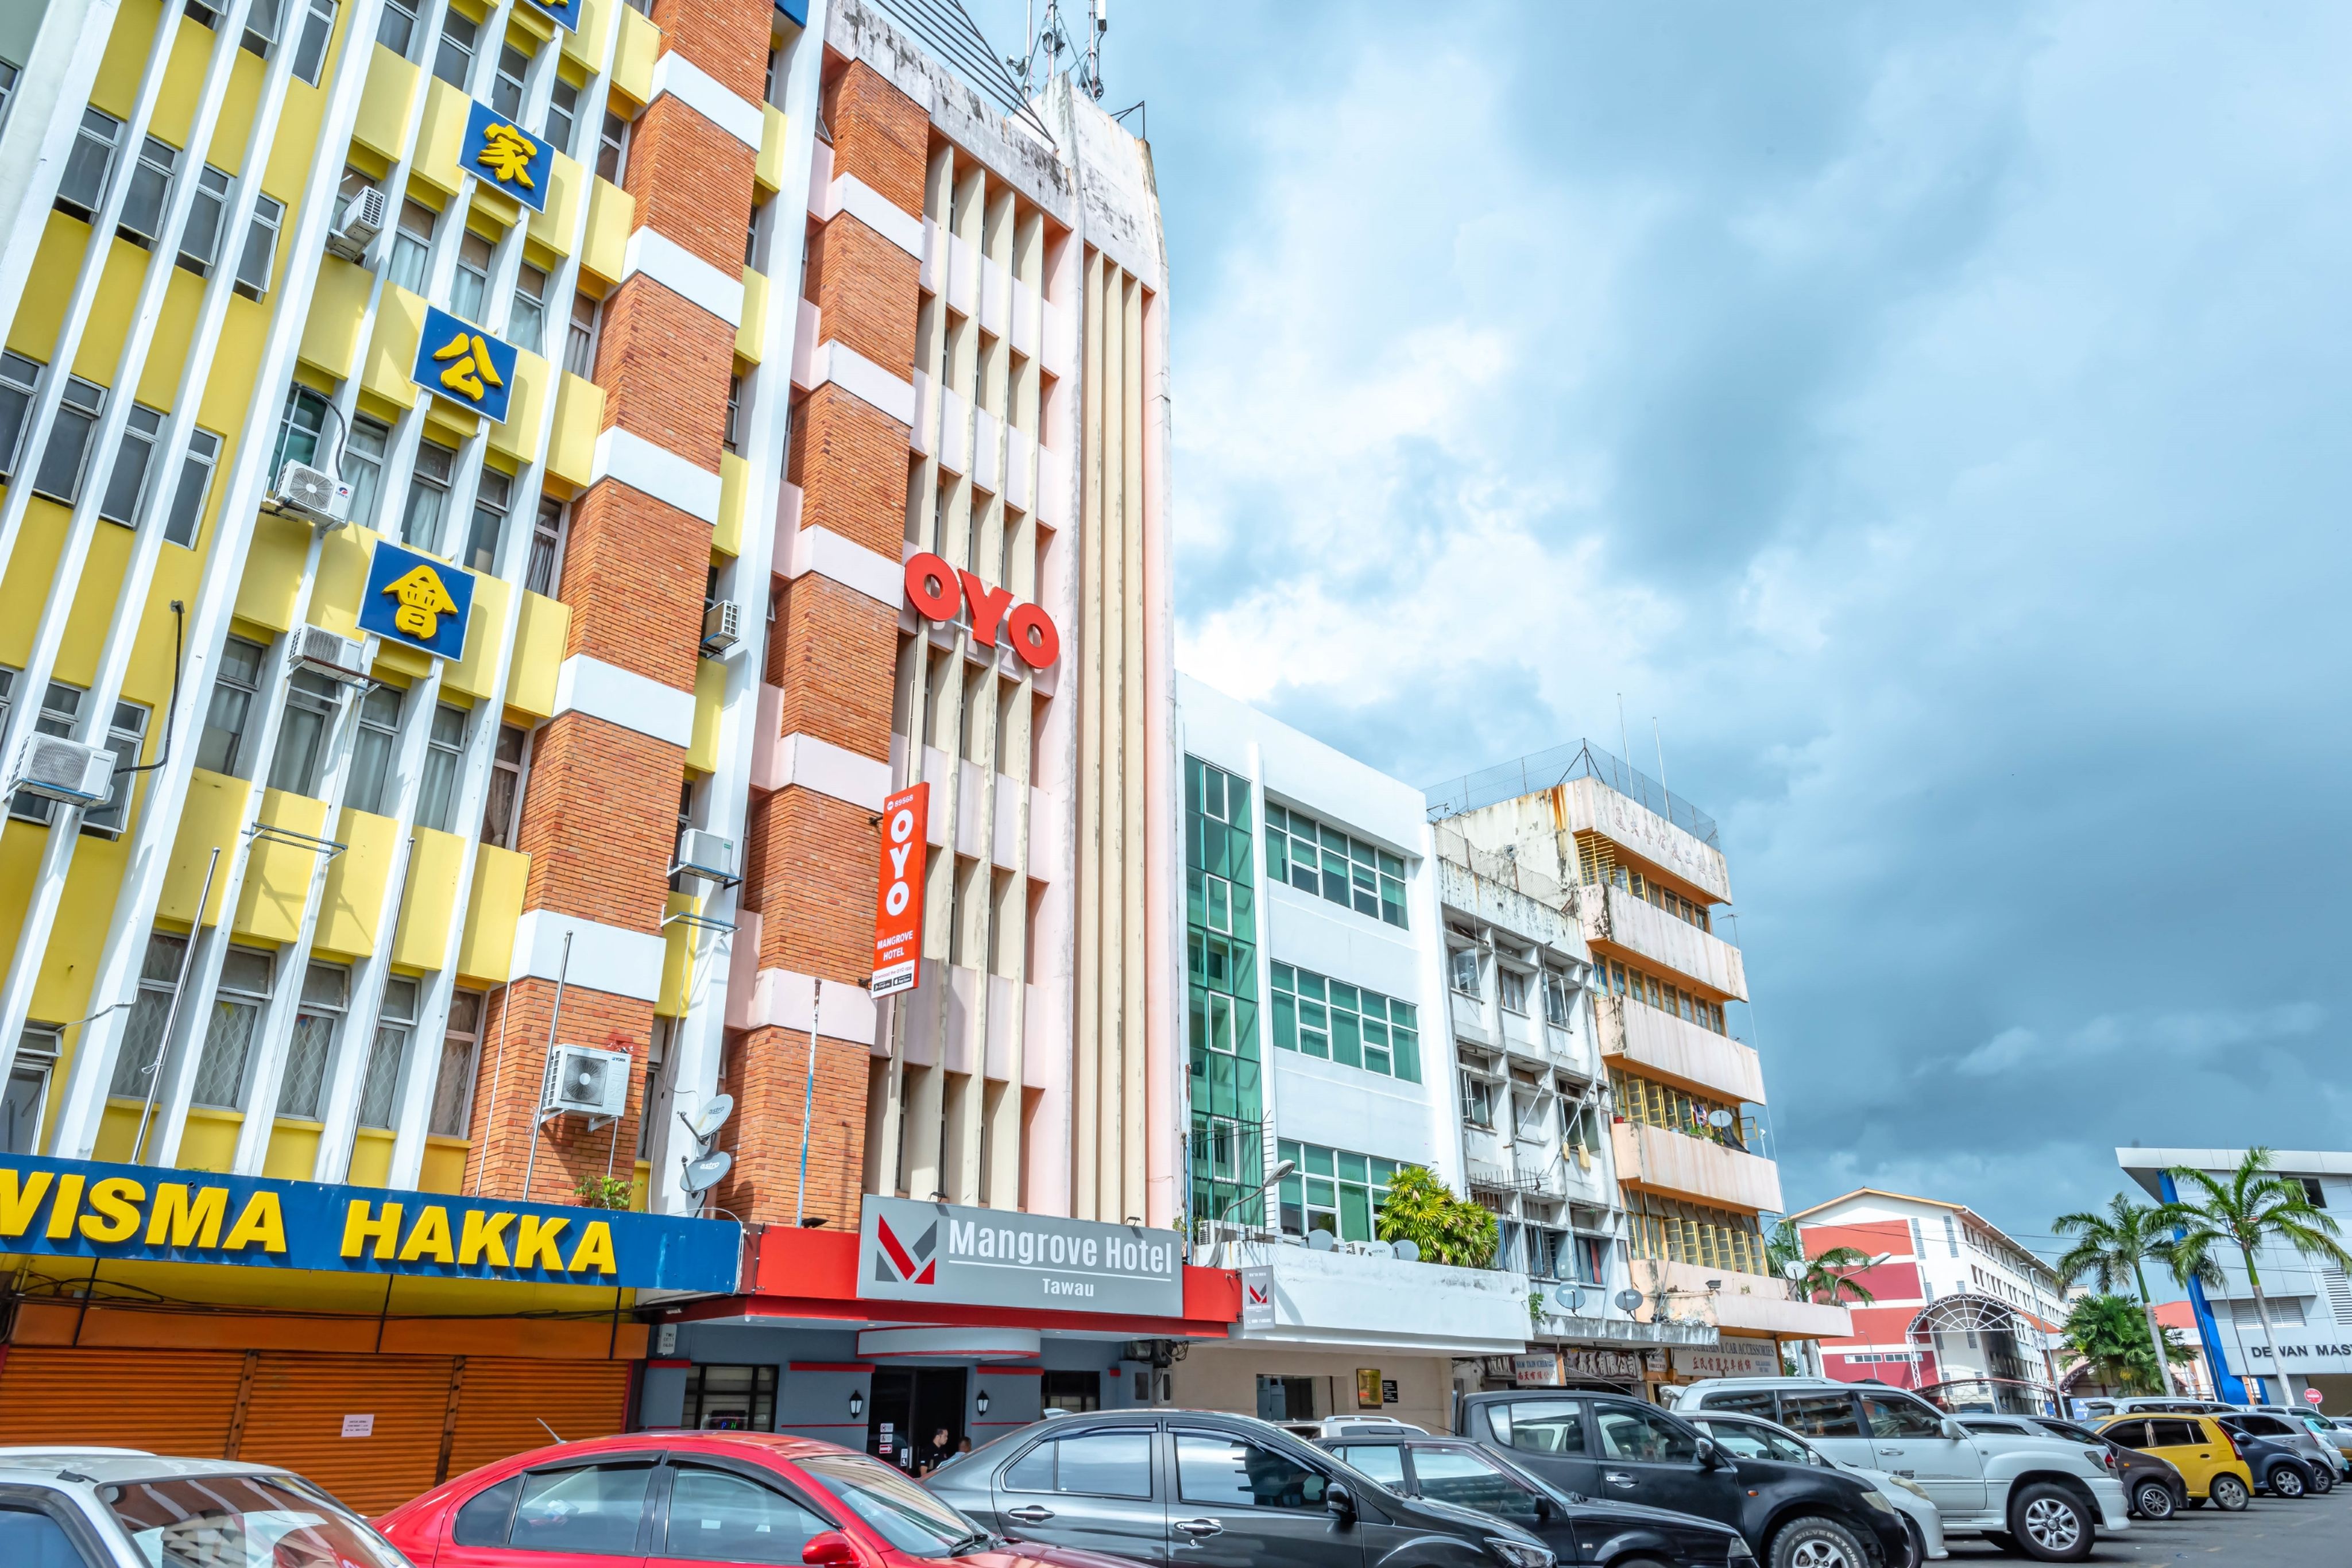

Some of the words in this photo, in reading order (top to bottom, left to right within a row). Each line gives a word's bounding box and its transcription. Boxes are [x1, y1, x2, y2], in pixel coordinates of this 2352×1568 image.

[477, 122, 537, 189] 家
[432, 332, 504, 402] 公
[382, 564, 459, 640] 會
[904, 552, 1060, 669] OYO
[886, 809, 914, 916] OYO
[877, 930, 914, 950] MANGROVE
[883, 947, 904, 961] HOTEL
[708, 1105, 725, 1115] astro
[699, 1161, 720, 1170] astro
[340, 1199, 617, 1275] HAKKA
[949, 1219, 1097, 1267] Mangrove
[1106, 1236, 1172, 1273] Hotel
[1042, 1278, 1094, 1297] Tawau
[1725, 1342, 1737, 1354] CAR
[1738, 1343, 1775, 1357] ACCESSORIES
[2315, 1344, 2352, 1356] MAS
[1795, 1529, 1860, 1568] SILVERSTONE
